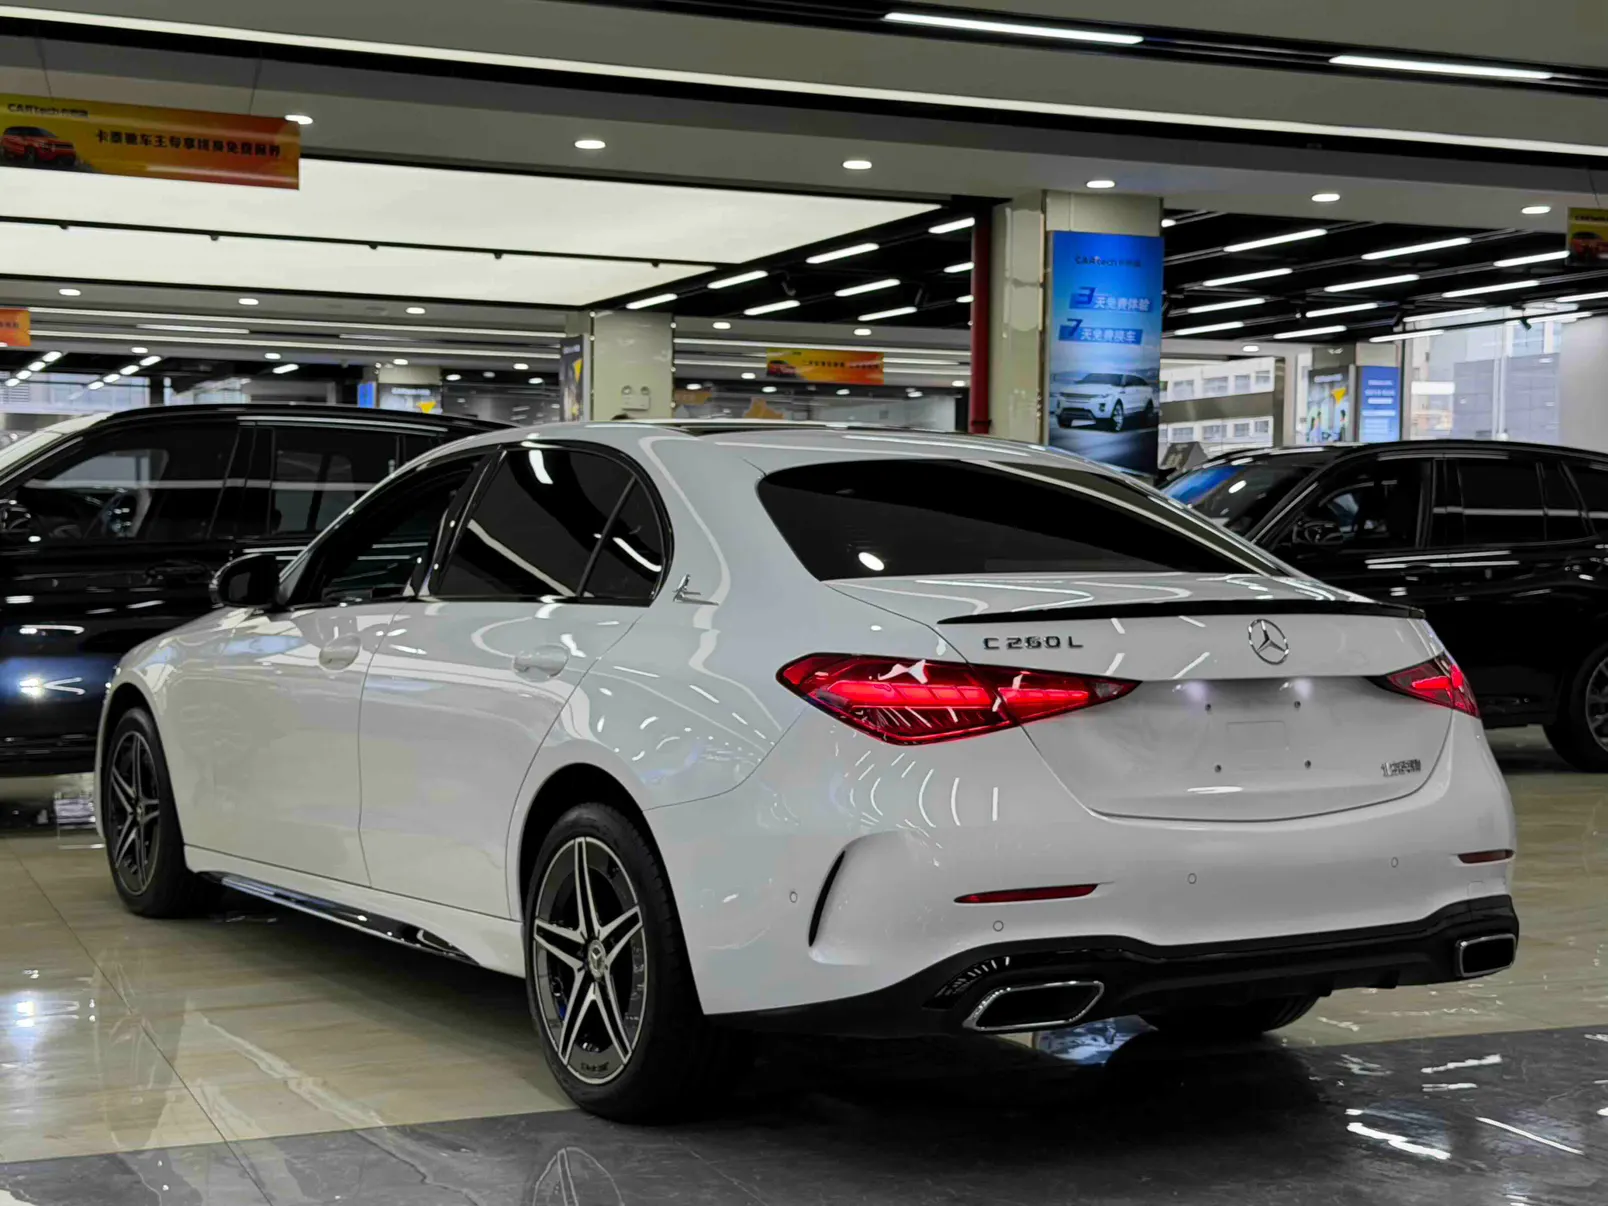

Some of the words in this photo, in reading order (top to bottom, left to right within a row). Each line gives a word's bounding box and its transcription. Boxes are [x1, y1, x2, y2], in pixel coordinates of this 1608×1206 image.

[983, 637, 1000, 650] C
[1005, 635, 1062, 650] 260
[1067, 635, 1084, 649] L
